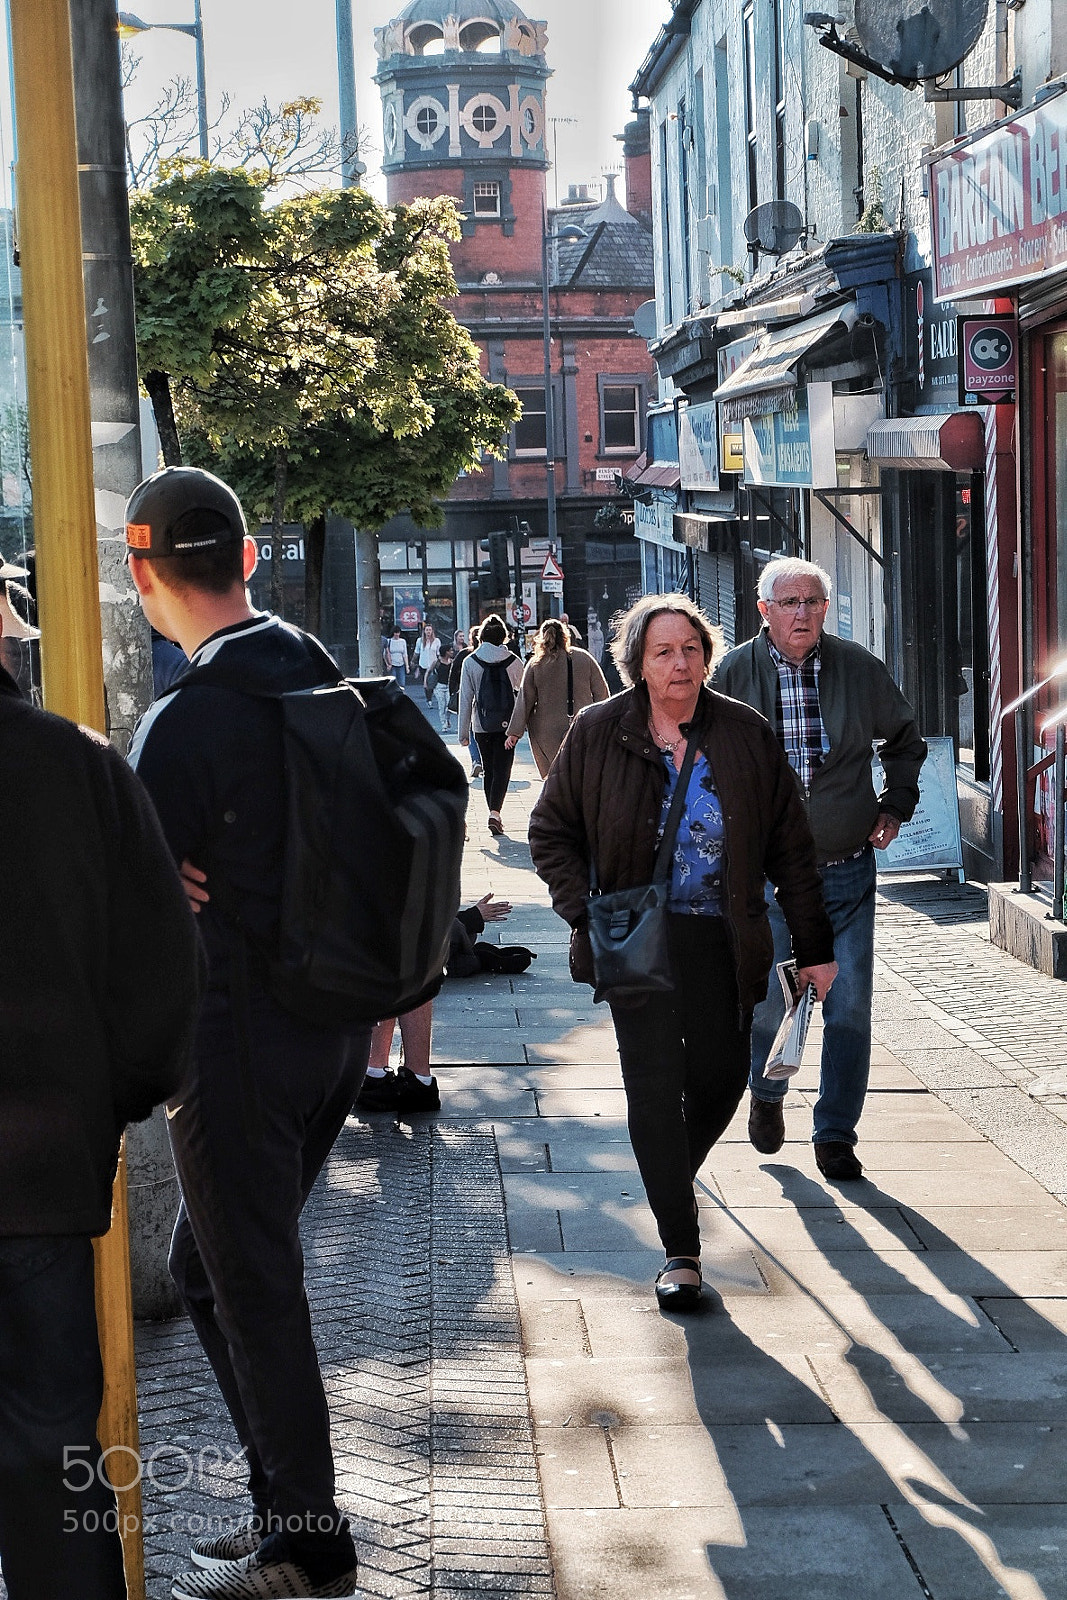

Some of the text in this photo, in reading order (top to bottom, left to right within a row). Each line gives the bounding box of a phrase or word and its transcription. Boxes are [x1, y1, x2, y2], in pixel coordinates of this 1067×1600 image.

[937, 132, 1025, 258] BARGAIN
[966, 246, 1014, 282] Confectioneries
[1019, 236, 1048, 267] Grocery
[968, 374, 1015, 387] payzone
[403, 611, 418, 623] £3
